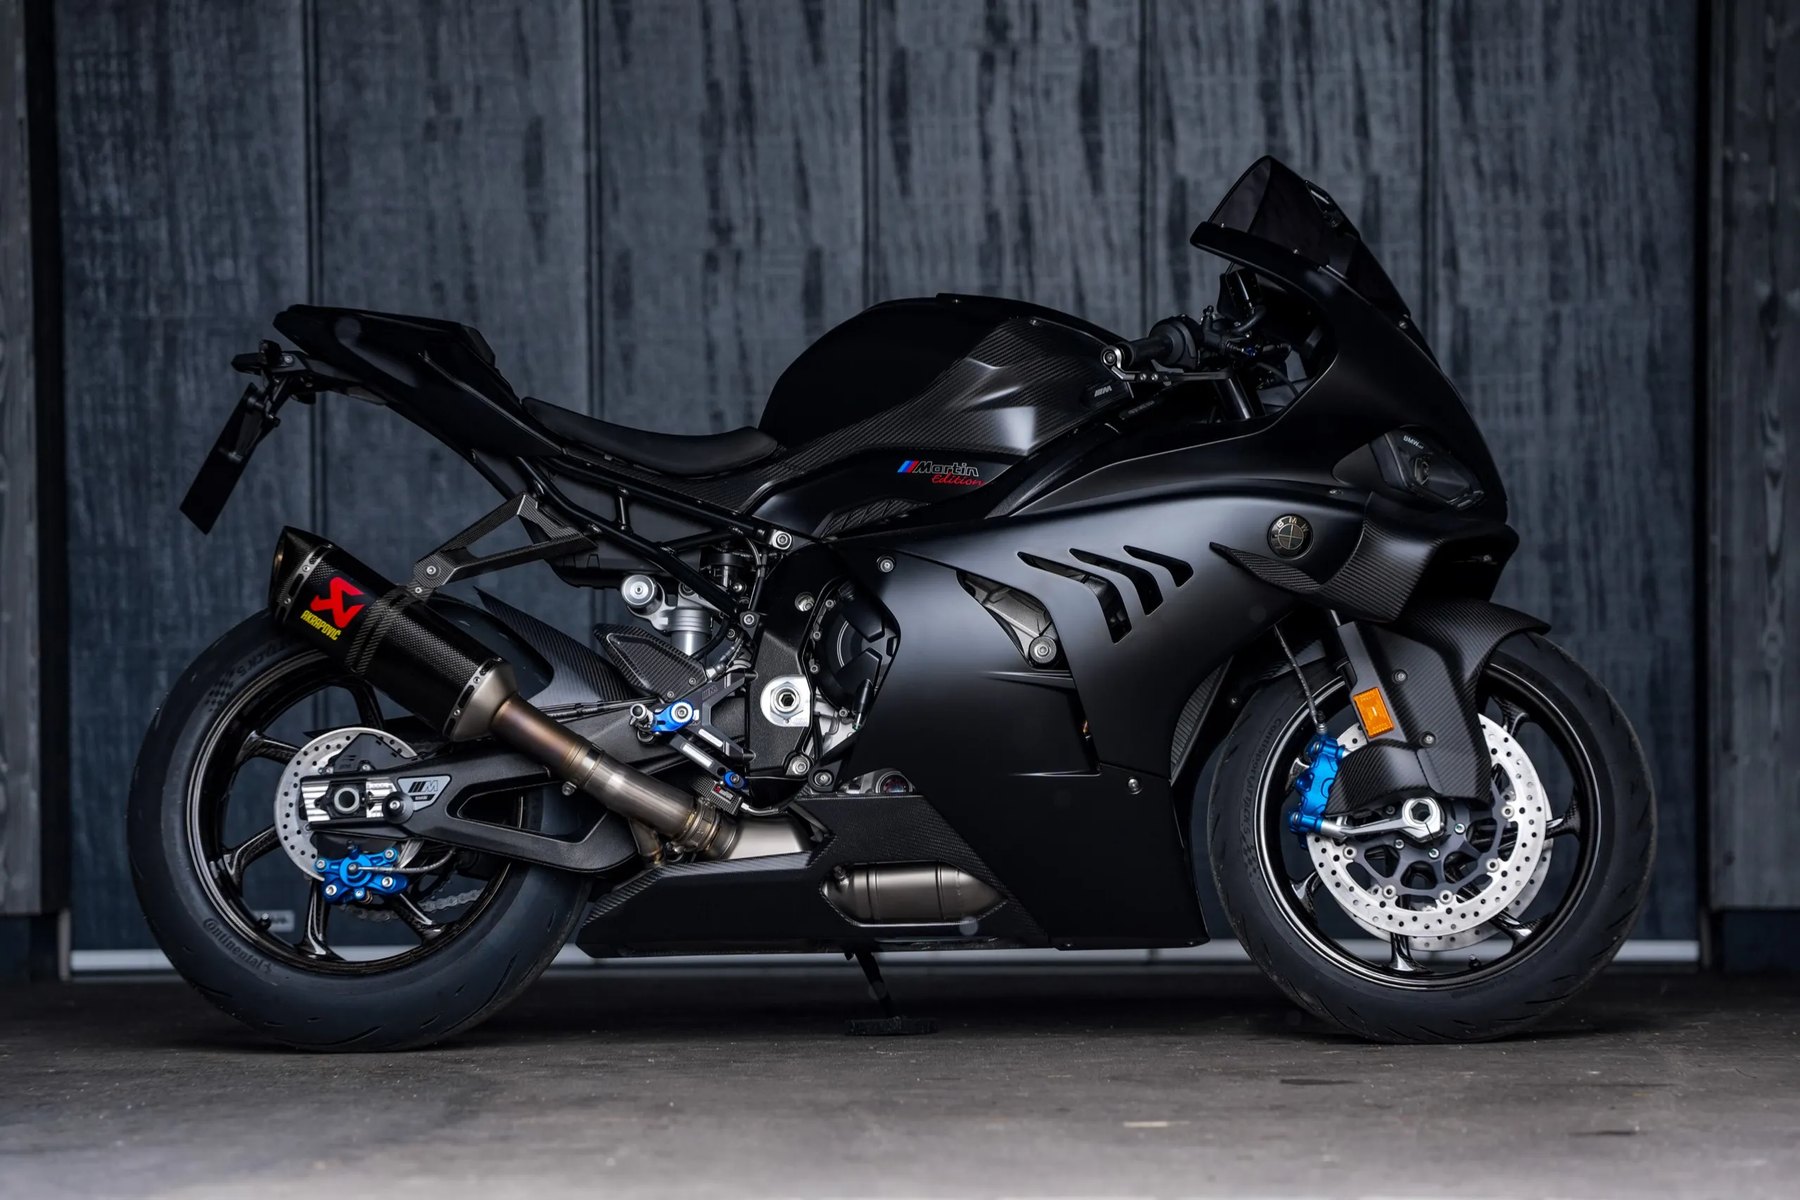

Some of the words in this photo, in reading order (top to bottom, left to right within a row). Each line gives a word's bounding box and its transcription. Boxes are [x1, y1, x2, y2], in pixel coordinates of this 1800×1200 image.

[912, 461, 979, 477] Martin
[931, 472, 985, 487] Edition
[1276, 516, 1309, 532] BMW
[203, 918, 265, 969] Continental
